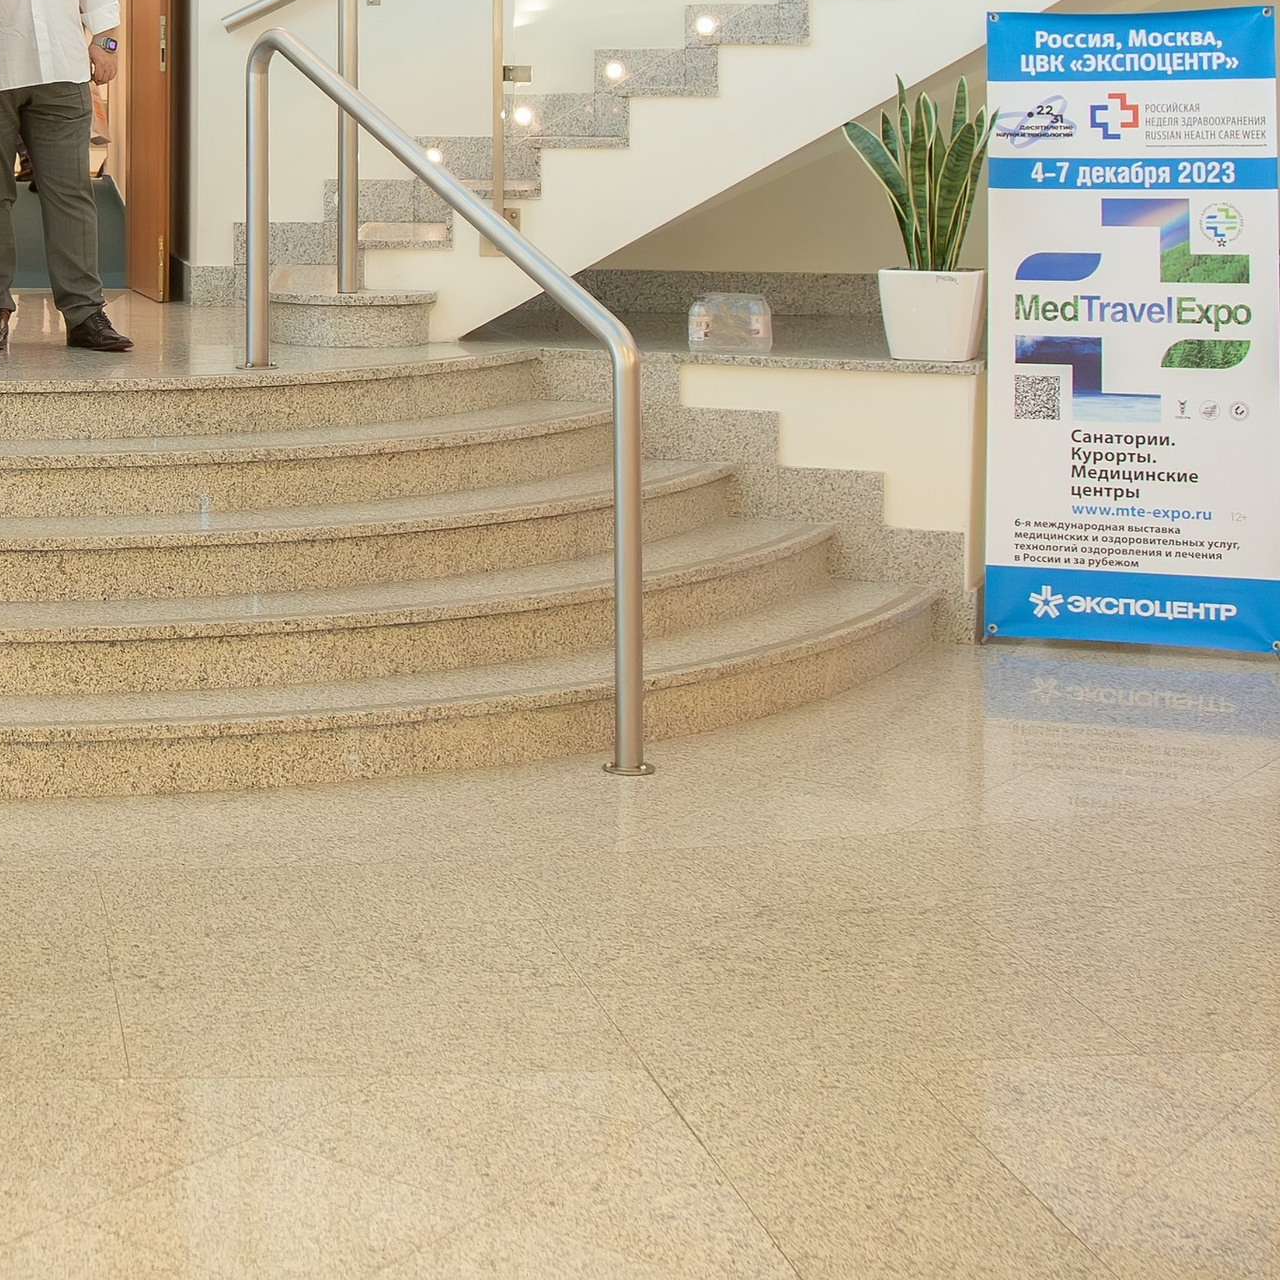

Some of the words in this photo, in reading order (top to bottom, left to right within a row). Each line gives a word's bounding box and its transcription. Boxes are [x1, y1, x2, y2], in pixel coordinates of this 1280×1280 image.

[1035, 30, 1123, 50] Россия,
[1128, 29, 1222, 48] Москва,
[1021, 54, 1065, 76] ЦВК
[1070, 52, 1239, 75] «ЭКСПОЦЕНТР»
[1145, 102, 1200, 113] РОССИЙСКАЯ
[1145, 117, 1179, 127] НЕДЕЛЯ
[1181, 116, 1266, 127] ЗДРАВООХРАНЕНИЯ
[1145, 130, 1181, 140] RUSSIAN
[1184, 130, 1216, 140] HEALTH
[1219, 130, 1240, 140] CARE
[1242, 130, 1266, 139] WEEK
[1077, 162, 1170, 187] декабря
[1178, 161, 1236, 183] 2023
[1015, 294, 1252, 331] MedTravelExpo
[1071, 429, 1176, 448] Санатории.
[1071, 447, 1157, 465] Курорты.
[1071, 465, 1199, 483] Медицинские
[1071, 486, 1140, 501] центры
[1072, 505, 1213, 522] www.mte-expo.ru
[1014, 519, 1031, 527] 6-я
[1033, 520, 1125, 532] международная
[1127, 524, 1181, 534] выставка
[1014, 531, 1089, 542] медицинских
[1091, 534, 1099, 542] и
[1101, 535, 1205, 548] оздоровительных
[1207, 541, 1240, 551] услуг,
[1014, 542, 1078, 553] технологий
[1080, 545, 1162, 557] оздоровления
[1174, 551, 1223, 560] лечения
[1023, 553, 1061, 564] России
[1073, 556, 1085, 565] за
[1088, 556, 1140, 568] рубежом
[1067, 595, 1238, 621] ЭКСПОЦЕНТР
